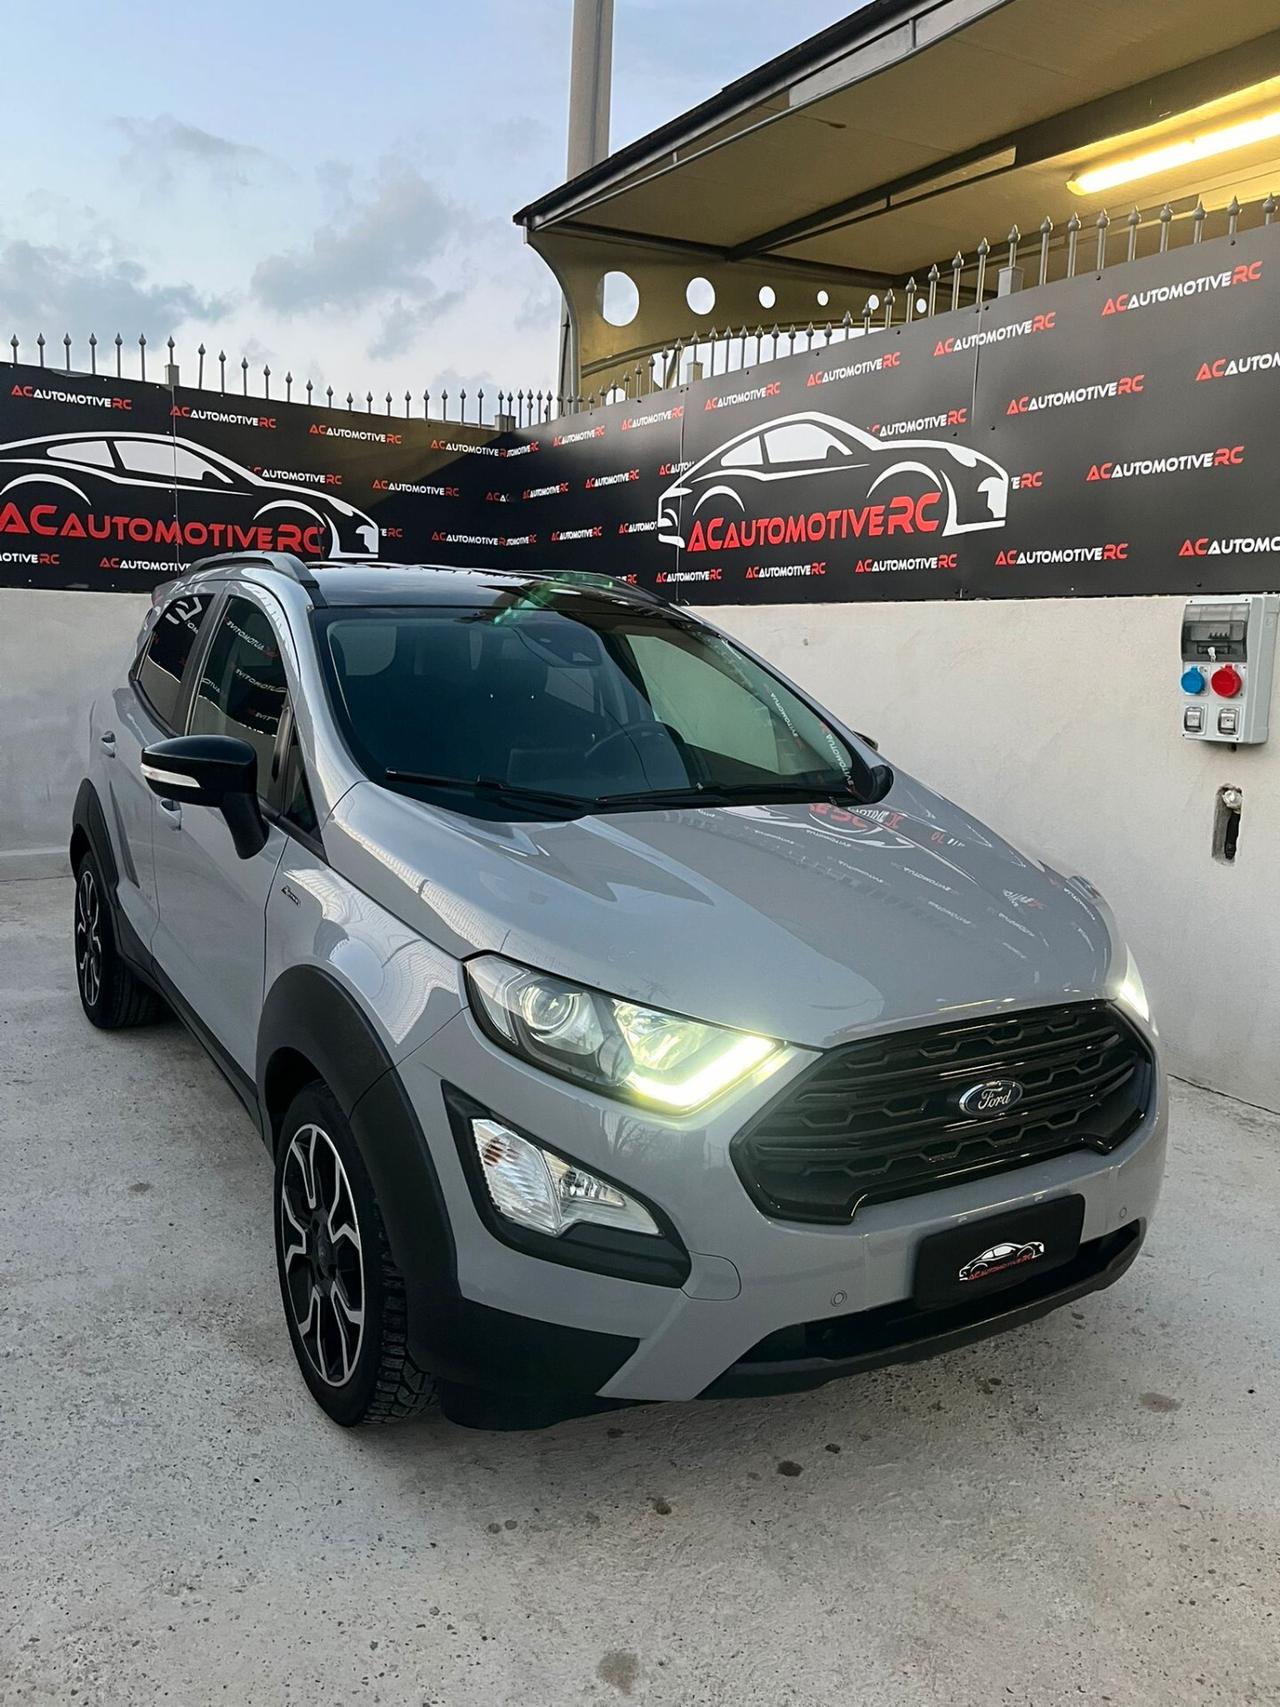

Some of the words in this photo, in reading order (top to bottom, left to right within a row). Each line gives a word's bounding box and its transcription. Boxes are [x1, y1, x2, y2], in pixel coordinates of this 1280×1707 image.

[1101, 260, 1263, 317] ACAUTOMOTIVERC
[934, 312, 1056, 356] ACAUTOMOTIVERC
[806, 352, 901, 387] ACAUTOMOTIVERC
[11, 385, 133, 410] ACAUTOMOTIVERC
[704, 382, 781, 411] ACAUTOMOTIVERC
[1006, 374, 1145, 415] ACAUTOMOTIVERC
[170, 405, 277, 428] ACAUTOMOTIVERC
[621, 406, 684, 431] ACAUTOMOTIVERC
[309, 423, 402, 444] ACAUTOMOTIVERC
[553, 425, 606, 447] ACAUTOMOTIVERC
[1086, 446, 1245, 482] ACAUTOMOTIVERC
[372, 479, 460, 497] ACAUTOMOTIVERC
[585, 469, 640, 489] ACAUTOMOTIVERC
[0, 502, 326, 554] ACAUTOMOTIVERC
[687, 491, 942, 552] ACAUTOMOTIVERC
[551, 526, 603, 542] ACAUTOMOTIVERC
[855, 553, 959, 573] ACAUTOMOTIVERC
[995, 543, 1128, 566] ACAUTOMOTIVERC
[656, 568, 722, 583] ACAUTOMOTIVERC
[745, 562, 826, 579] ACAUTOMOTIVERC
[977, 1087, 1012, 1110] Ford
